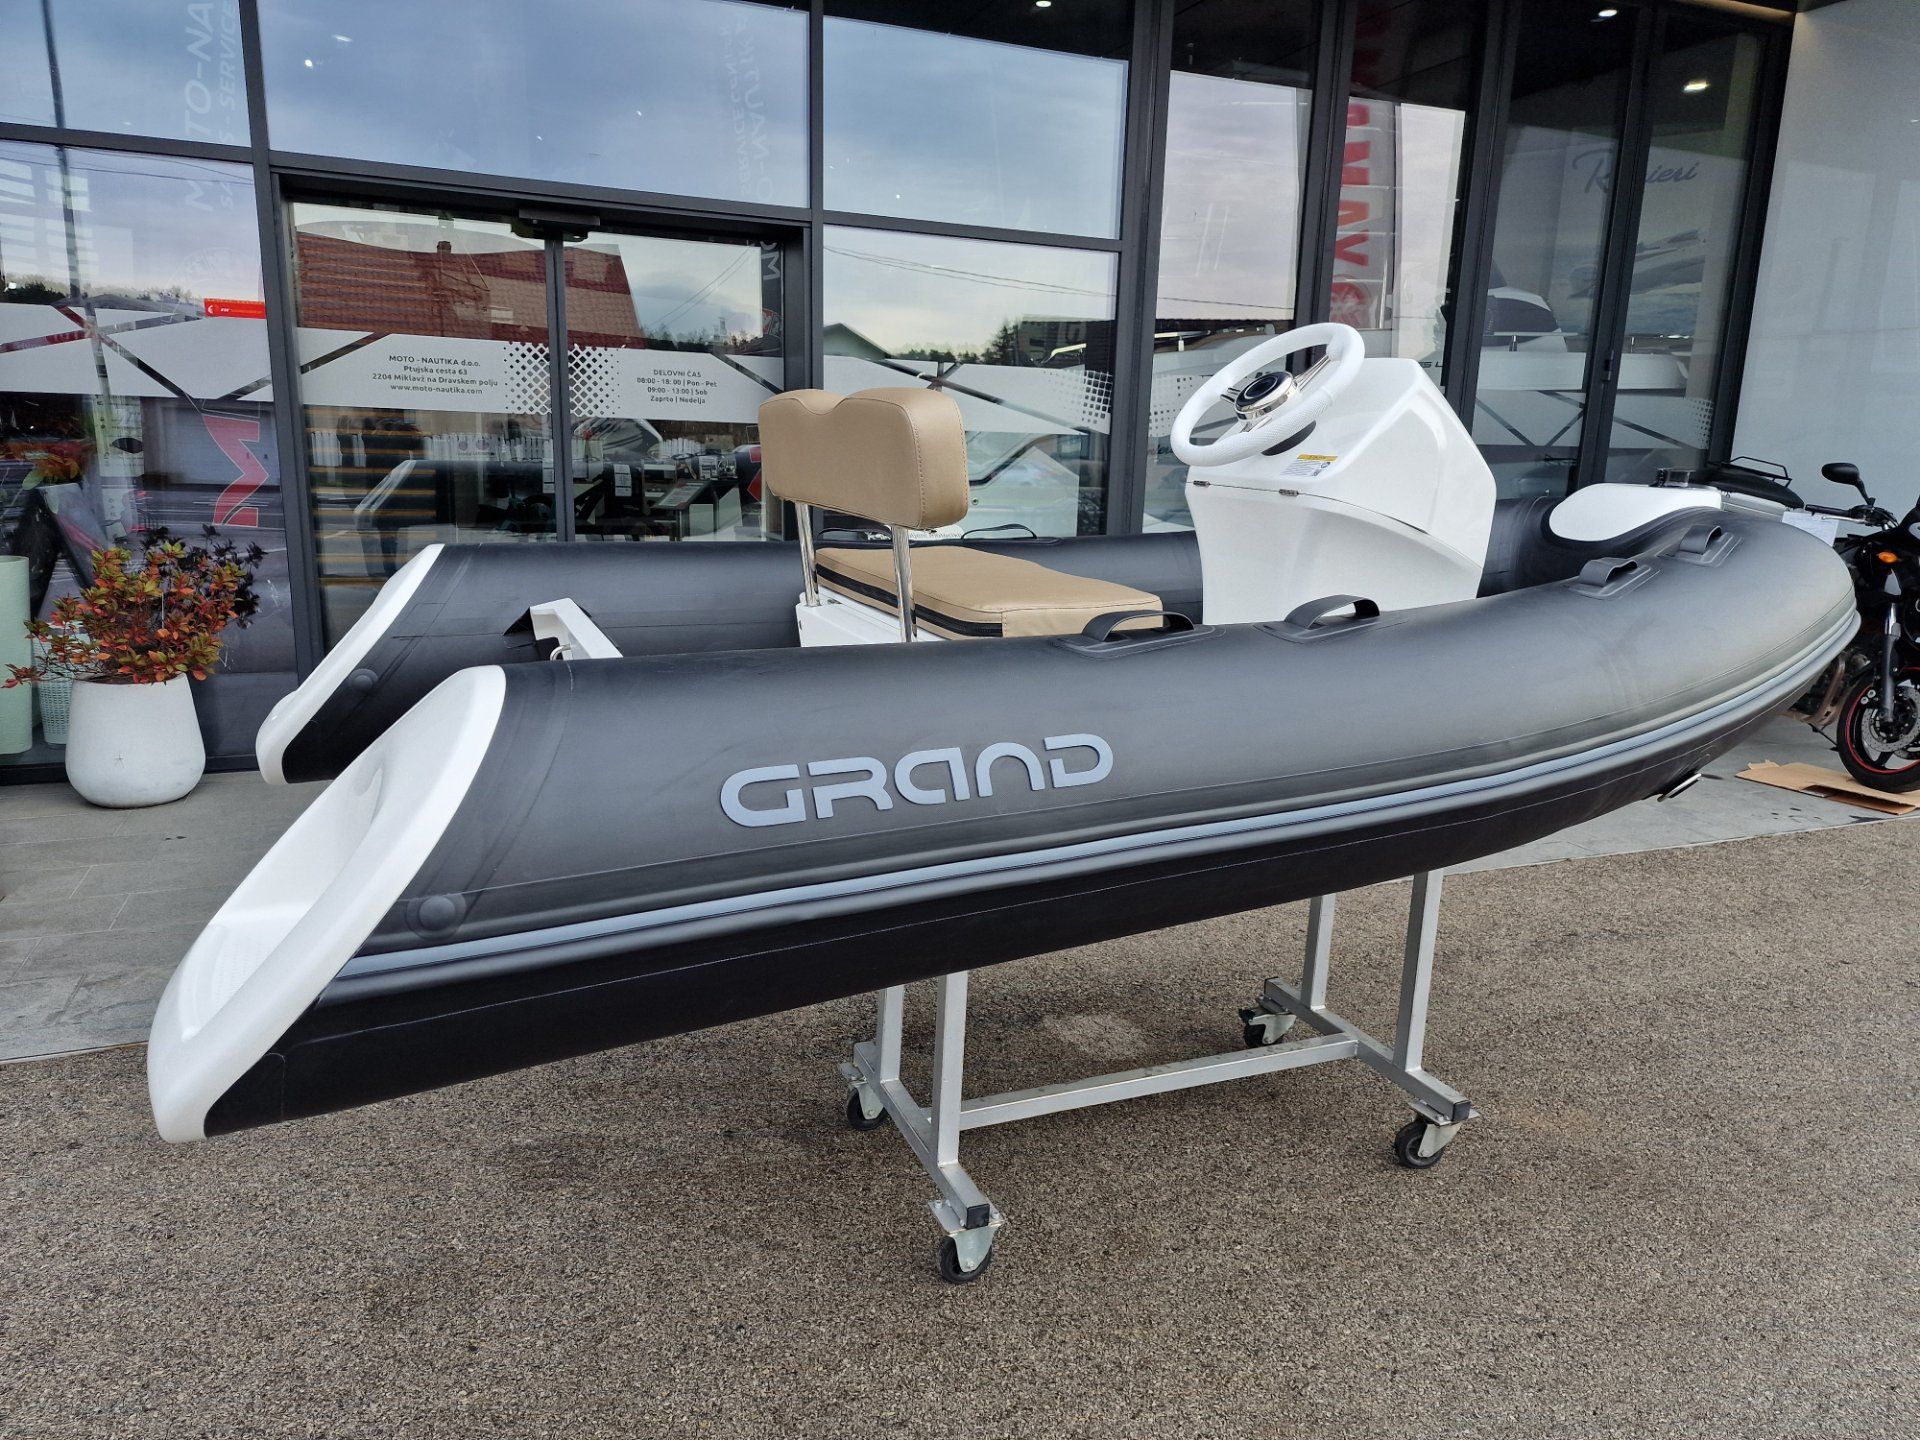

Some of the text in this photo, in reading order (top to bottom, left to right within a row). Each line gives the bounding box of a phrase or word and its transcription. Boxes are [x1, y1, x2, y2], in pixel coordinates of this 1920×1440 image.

[185, 0, 214, 213] MTO-NA
[389, 355, 415, 363] MOTO
[421, 357, 459, 366] NAUTIKA
[403, 365, 434, 374] Ptujska
[653, 369, 702, 378] DELOVNI ČAS
[394, 374, 425, 382] Miklavž
[438, 376, 477, 385] Dravskem
[479, 379, 498, 388] polju
[705, 380, 718, 388] Pet
[390, 384, 483, 395] www.moto-nautika.com
[695, 388, 708, 396] Sob
[650, 395, 674, 403] Zaprto
[679, 397, 706, 405] Nedelja
[720, 732, 1114, 828] GRAND
